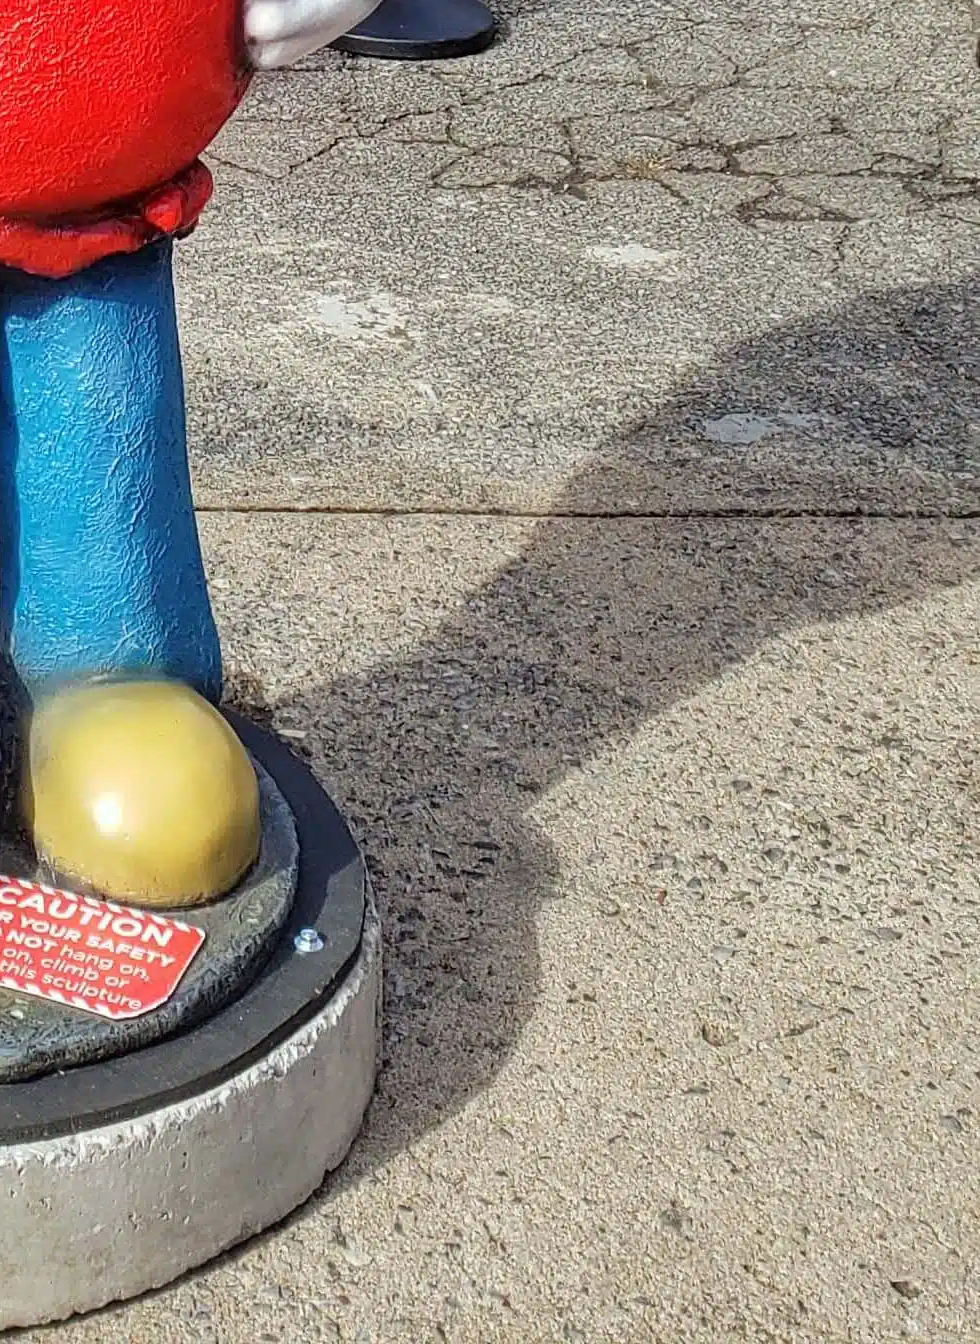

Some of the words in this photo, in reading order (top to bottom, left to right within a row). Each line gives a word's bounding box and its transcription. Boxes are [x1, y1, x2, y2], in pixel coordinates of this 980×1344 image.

[6, 929, 58, 952] NOT
[59, 944, 114, 971] hang
[119, 963, 151, 983] on,
[21, 914, 82, 943] YOUR
[85, 934, 176, 967] SAFETY
[40, 957, 99, 981] climb
[104, 976, 130, 989] or
[42, 973, 142, 1010] sculpture
